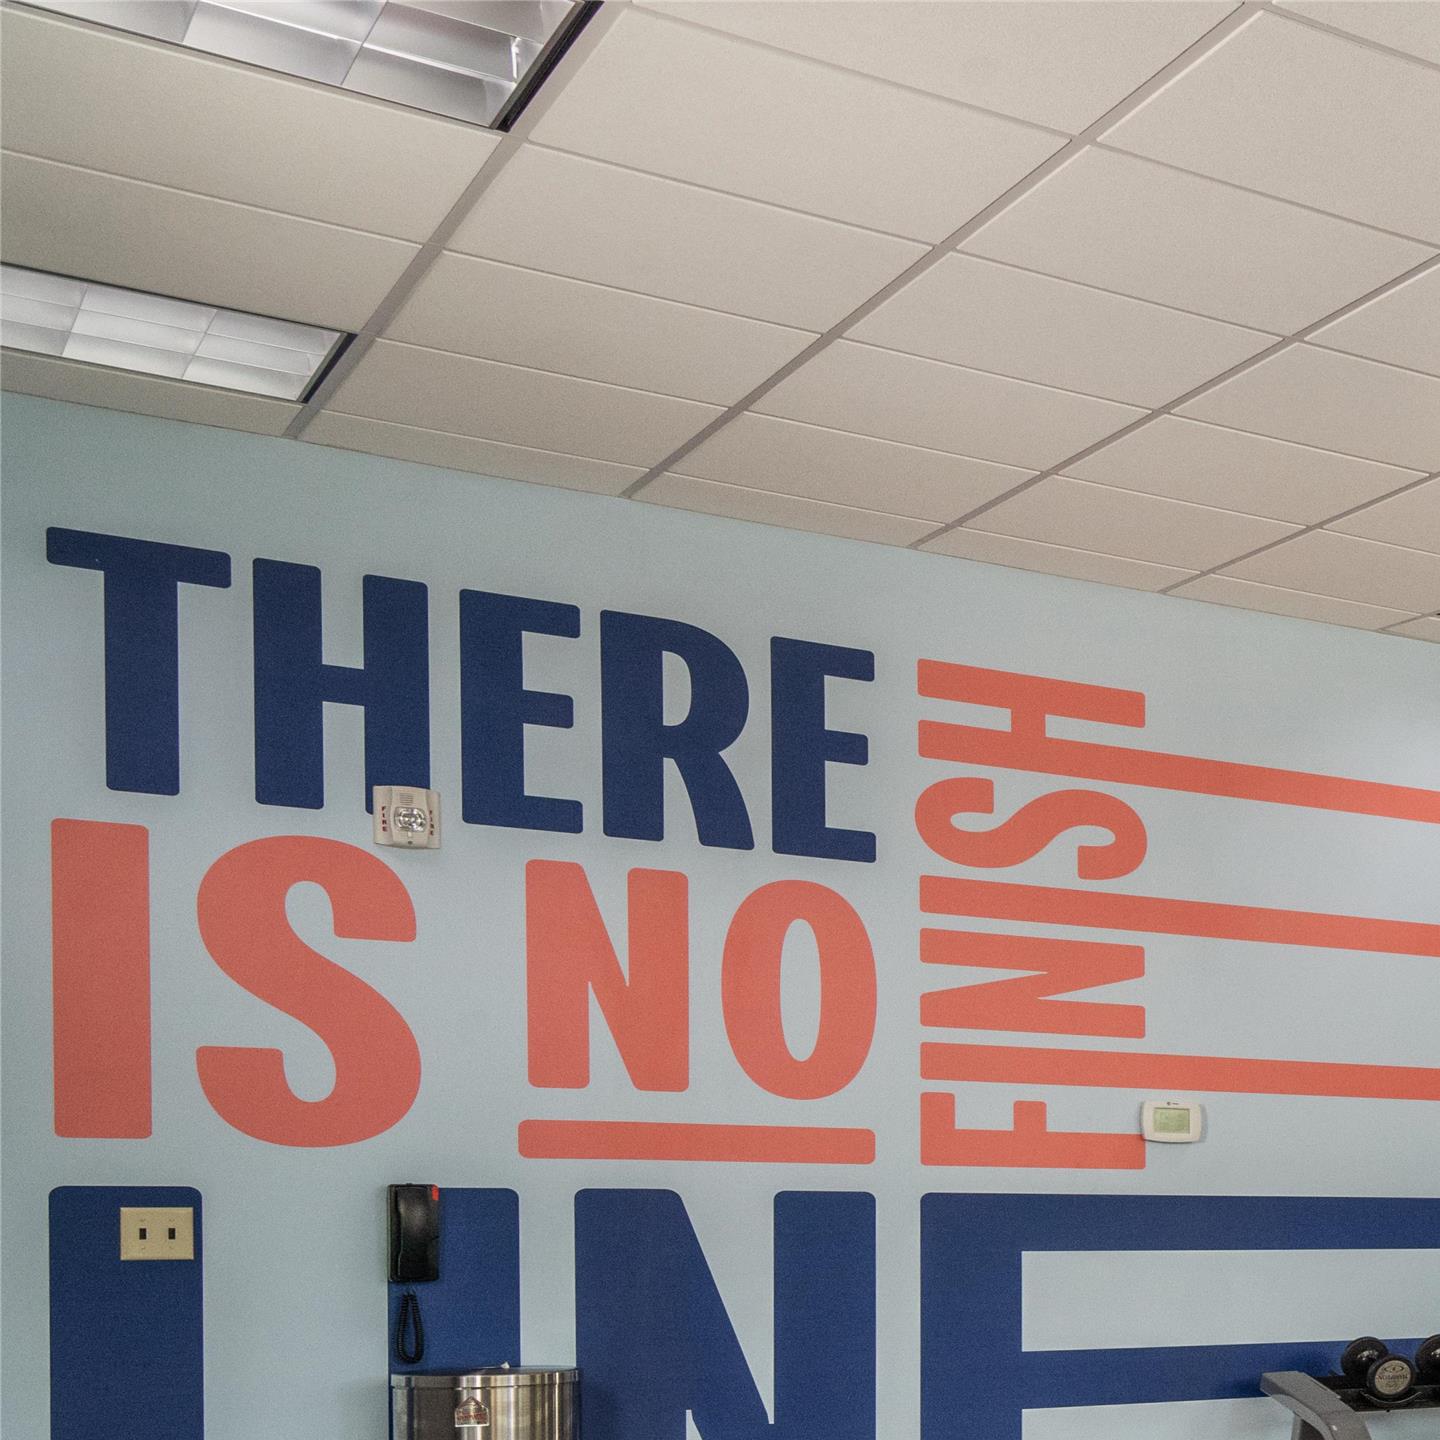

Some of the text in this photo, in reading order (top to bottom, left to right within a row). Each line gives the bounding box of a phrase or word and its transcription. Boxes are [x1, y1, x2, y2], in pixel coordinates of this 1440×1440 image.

[46, 526, 877, 863] THERE
[50, 817, 878, 1149] IS NO
[914, 657, 1147, 1169] FINISH
